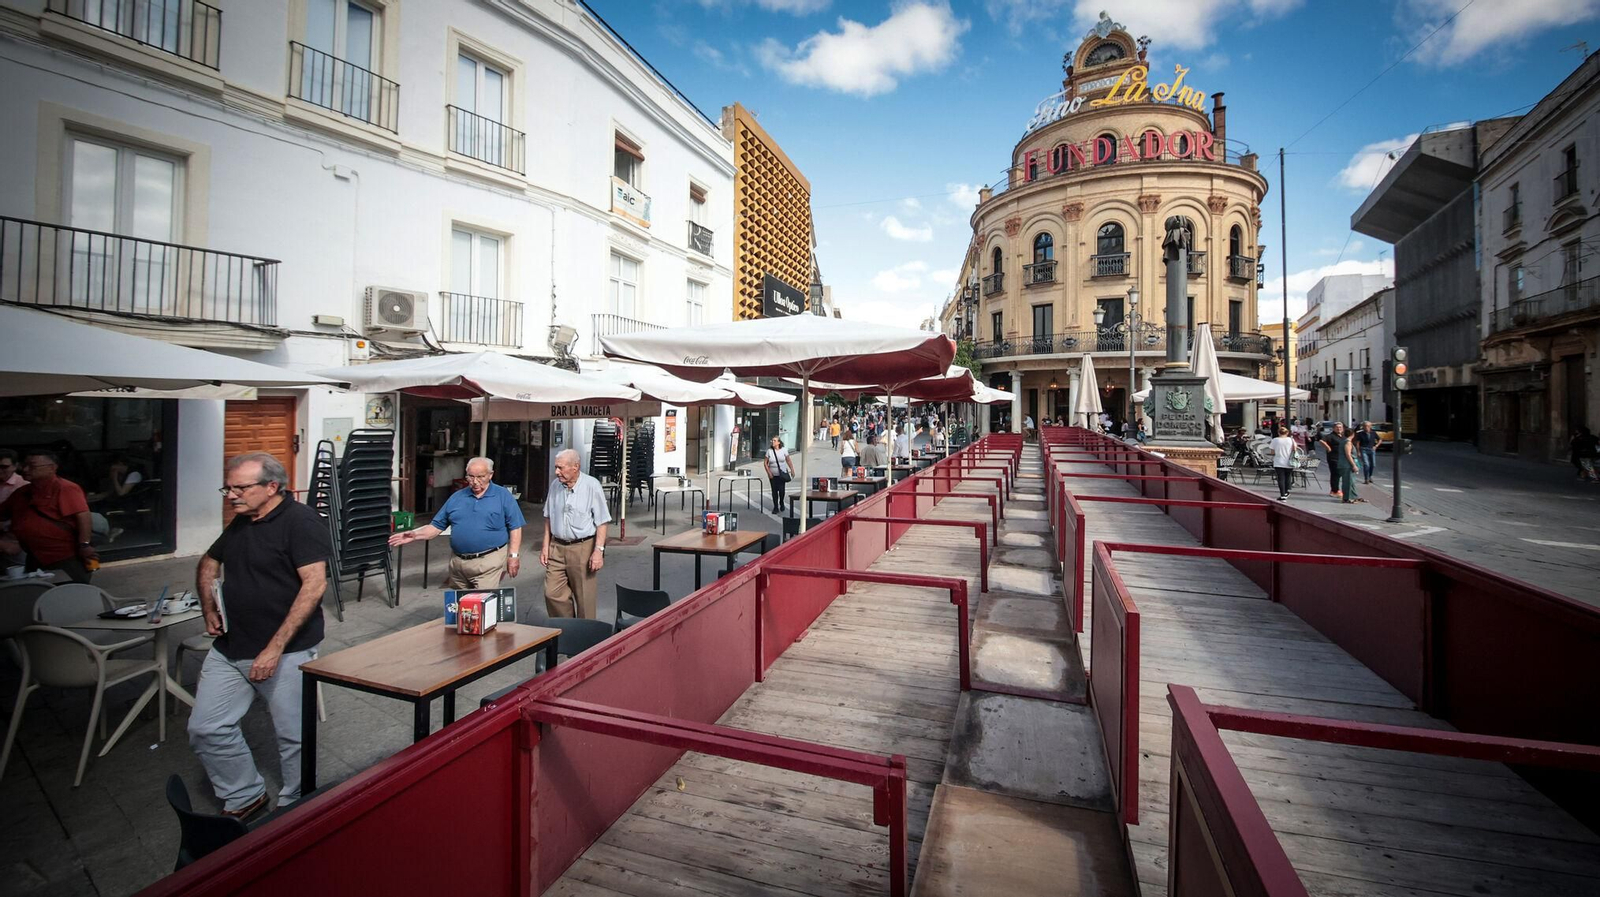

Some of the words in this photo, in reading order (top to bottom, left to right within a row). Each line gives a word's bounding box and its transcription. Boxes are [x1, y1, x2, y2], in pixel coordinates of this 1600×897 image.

[1026, 87, 1087, 131] Fino
[1090, 65, 1149, 107] La
[1023, 130, 1215, 183] FUNDADOR
[551, 405, 568, 417] BAR
[569, 405, 580, 416] LA
[581, 405, 611, 416] MACETA
[1161, 413, 1196, 421] PEDRO
